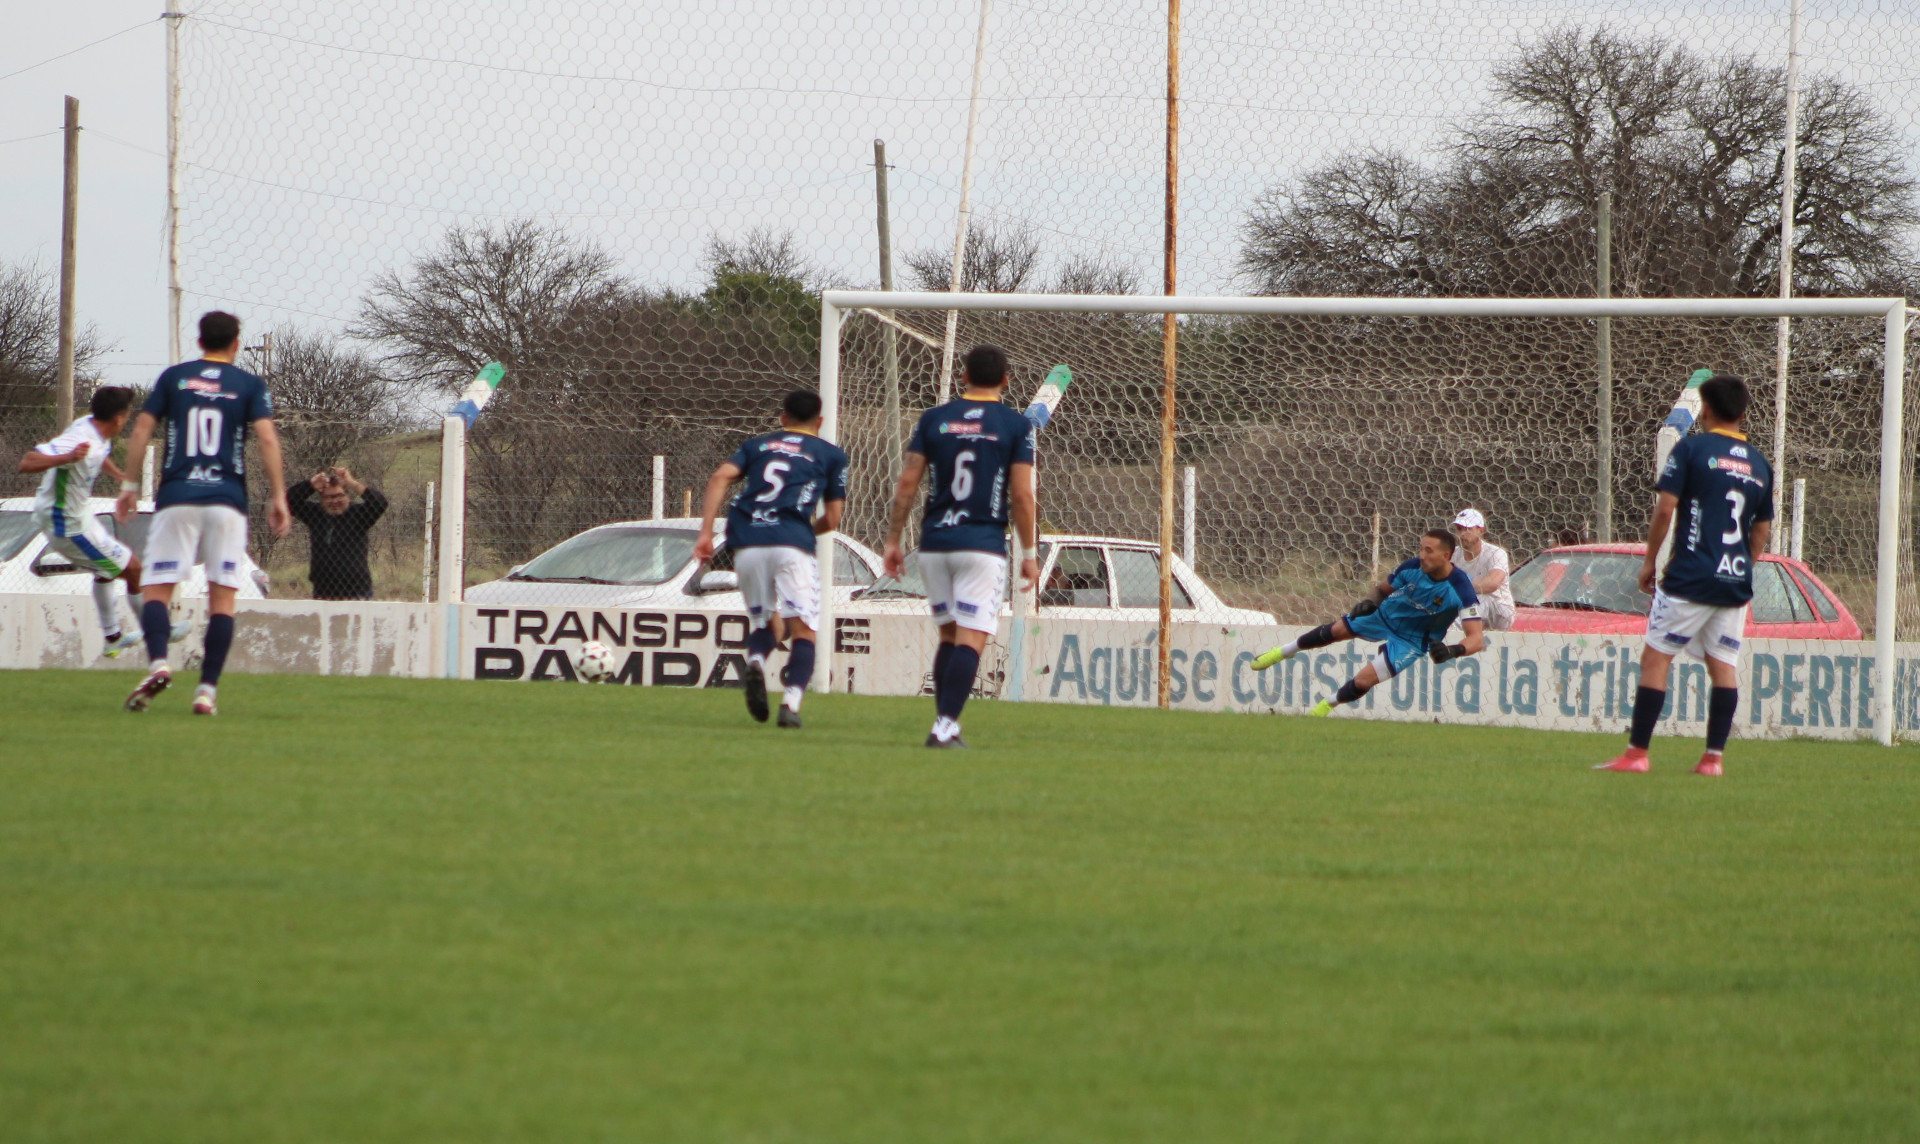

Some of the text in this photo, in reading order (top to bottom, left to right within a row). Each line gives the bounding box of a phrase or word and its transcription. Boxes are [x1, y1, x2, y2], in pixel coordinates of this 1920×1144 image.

[186, 406, 223, 457] 10
[755, 461, 791, 502] 5
[951, 451, 976, 501] 6
[1722, 490, 1745, 545] 3
[1716, 554, 1746, 577] AC
[477, 608, 871, 654] TRANSPOE
[1049, 628, 1158, 705] Aquí
[1169, 649, 1217, 703] se
[1498, 646, 1538, 716] la
